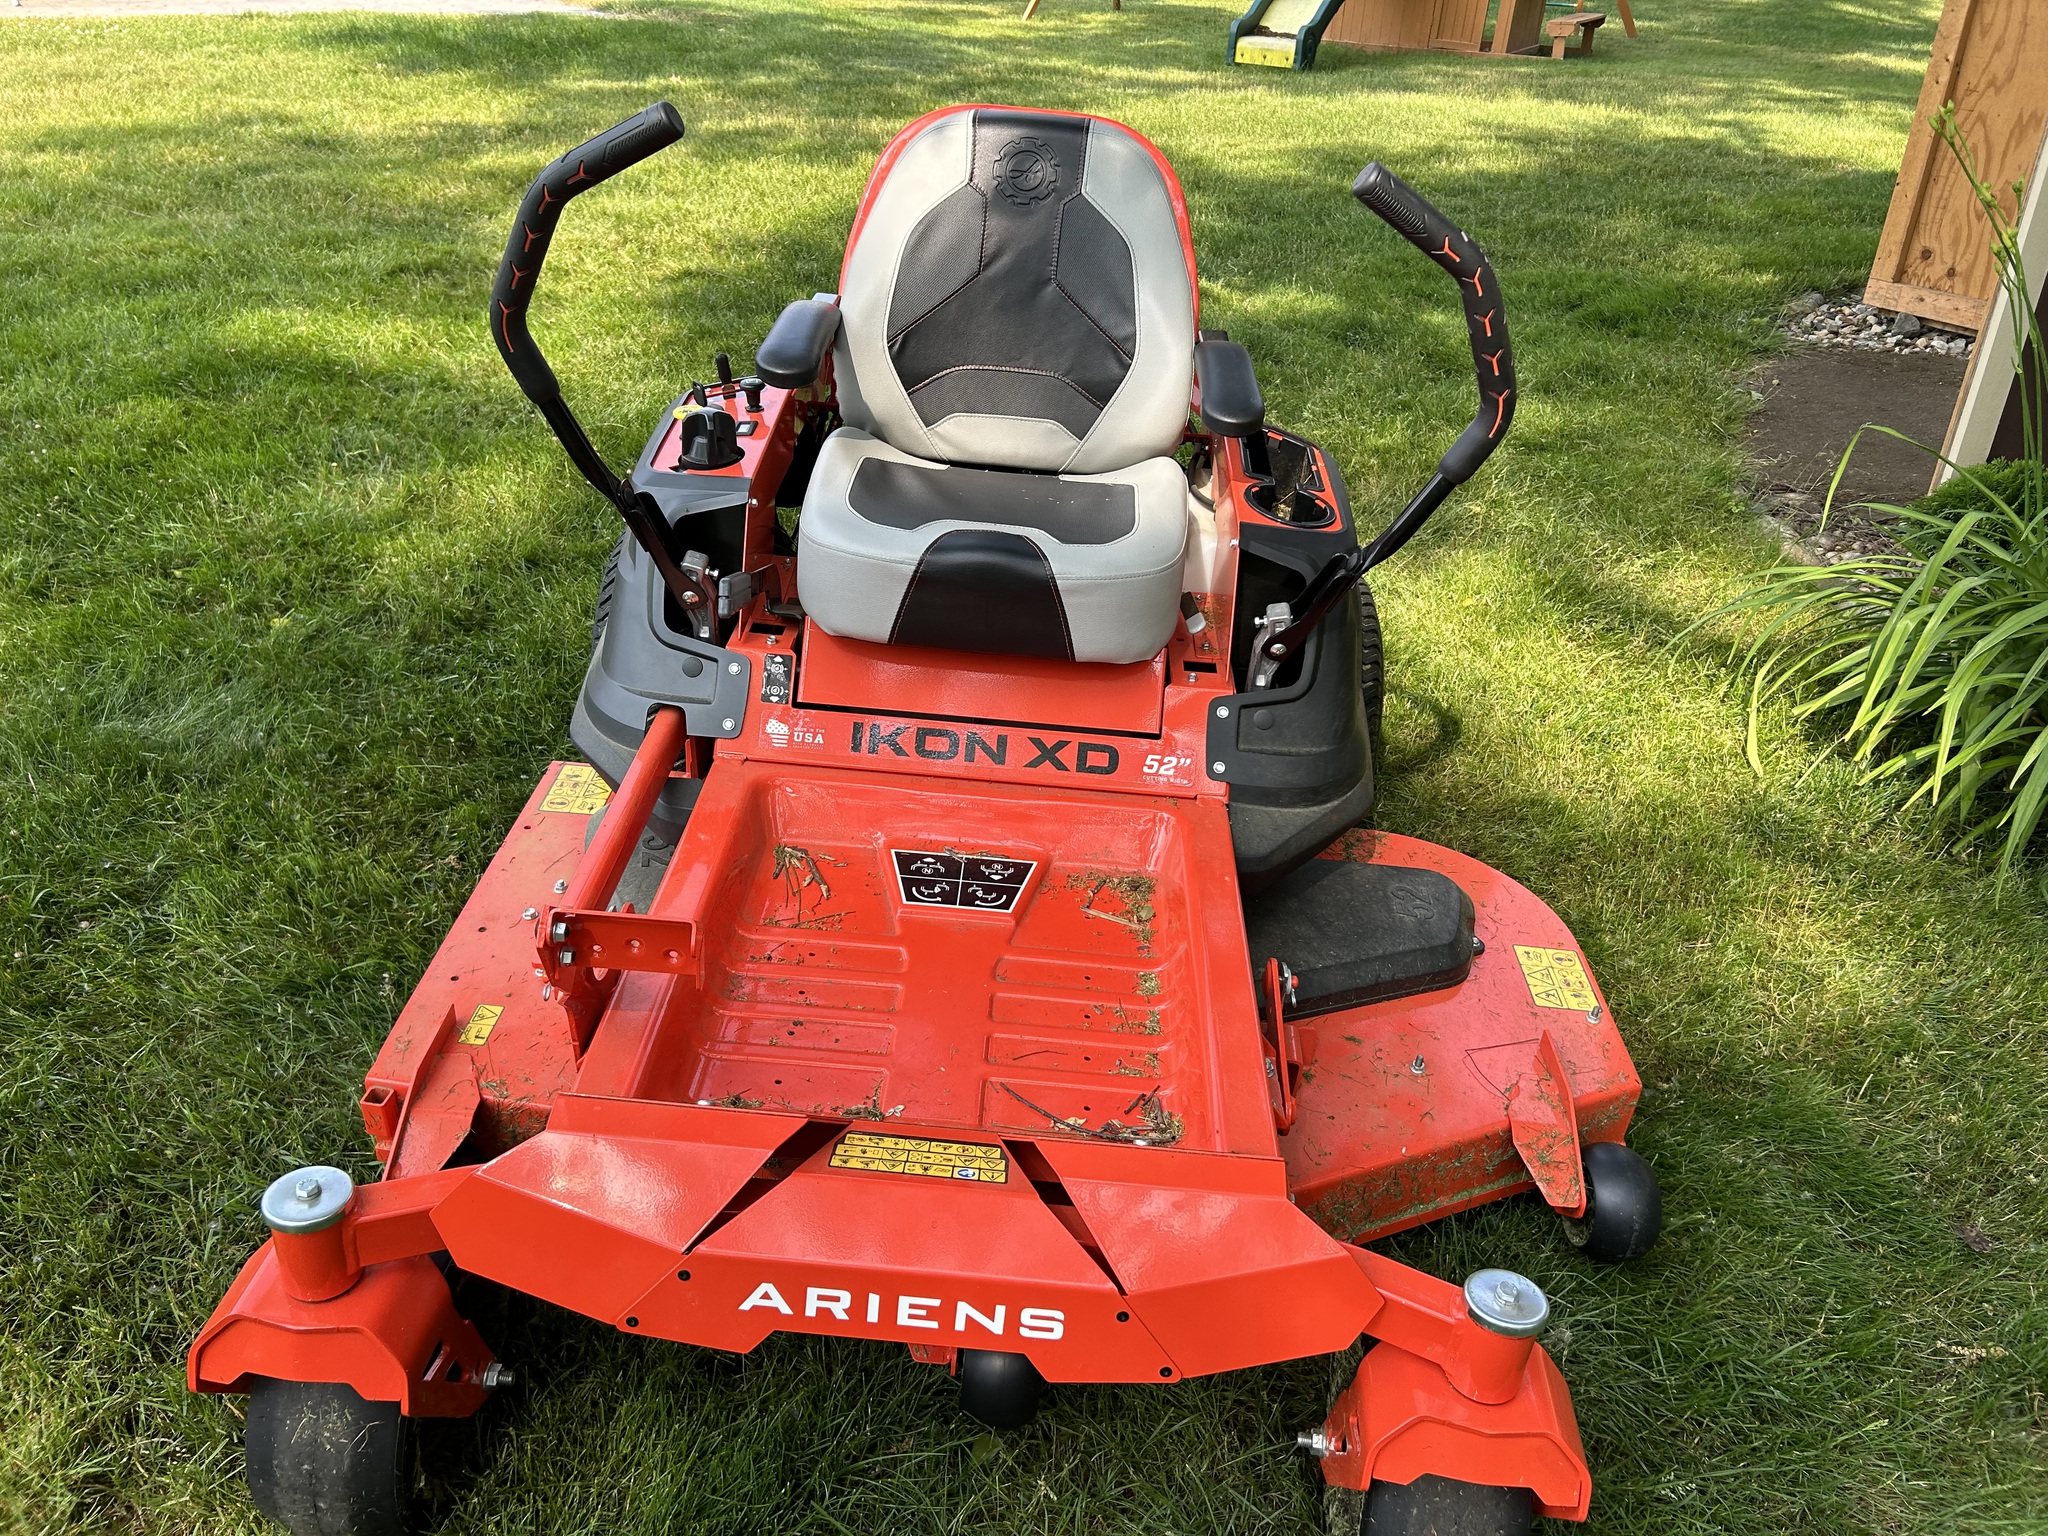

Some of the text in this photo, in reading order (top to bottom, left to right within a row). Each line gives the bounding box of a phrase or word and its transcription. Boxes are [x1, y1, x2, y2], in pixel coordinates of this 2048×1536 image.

[793, 731, 824, 744] USA
[850, 721, 1120, 776] IKON XD
[1390, 884, 1435, 920] 52
[738, 1282, 1065, 1340] ARIENS
